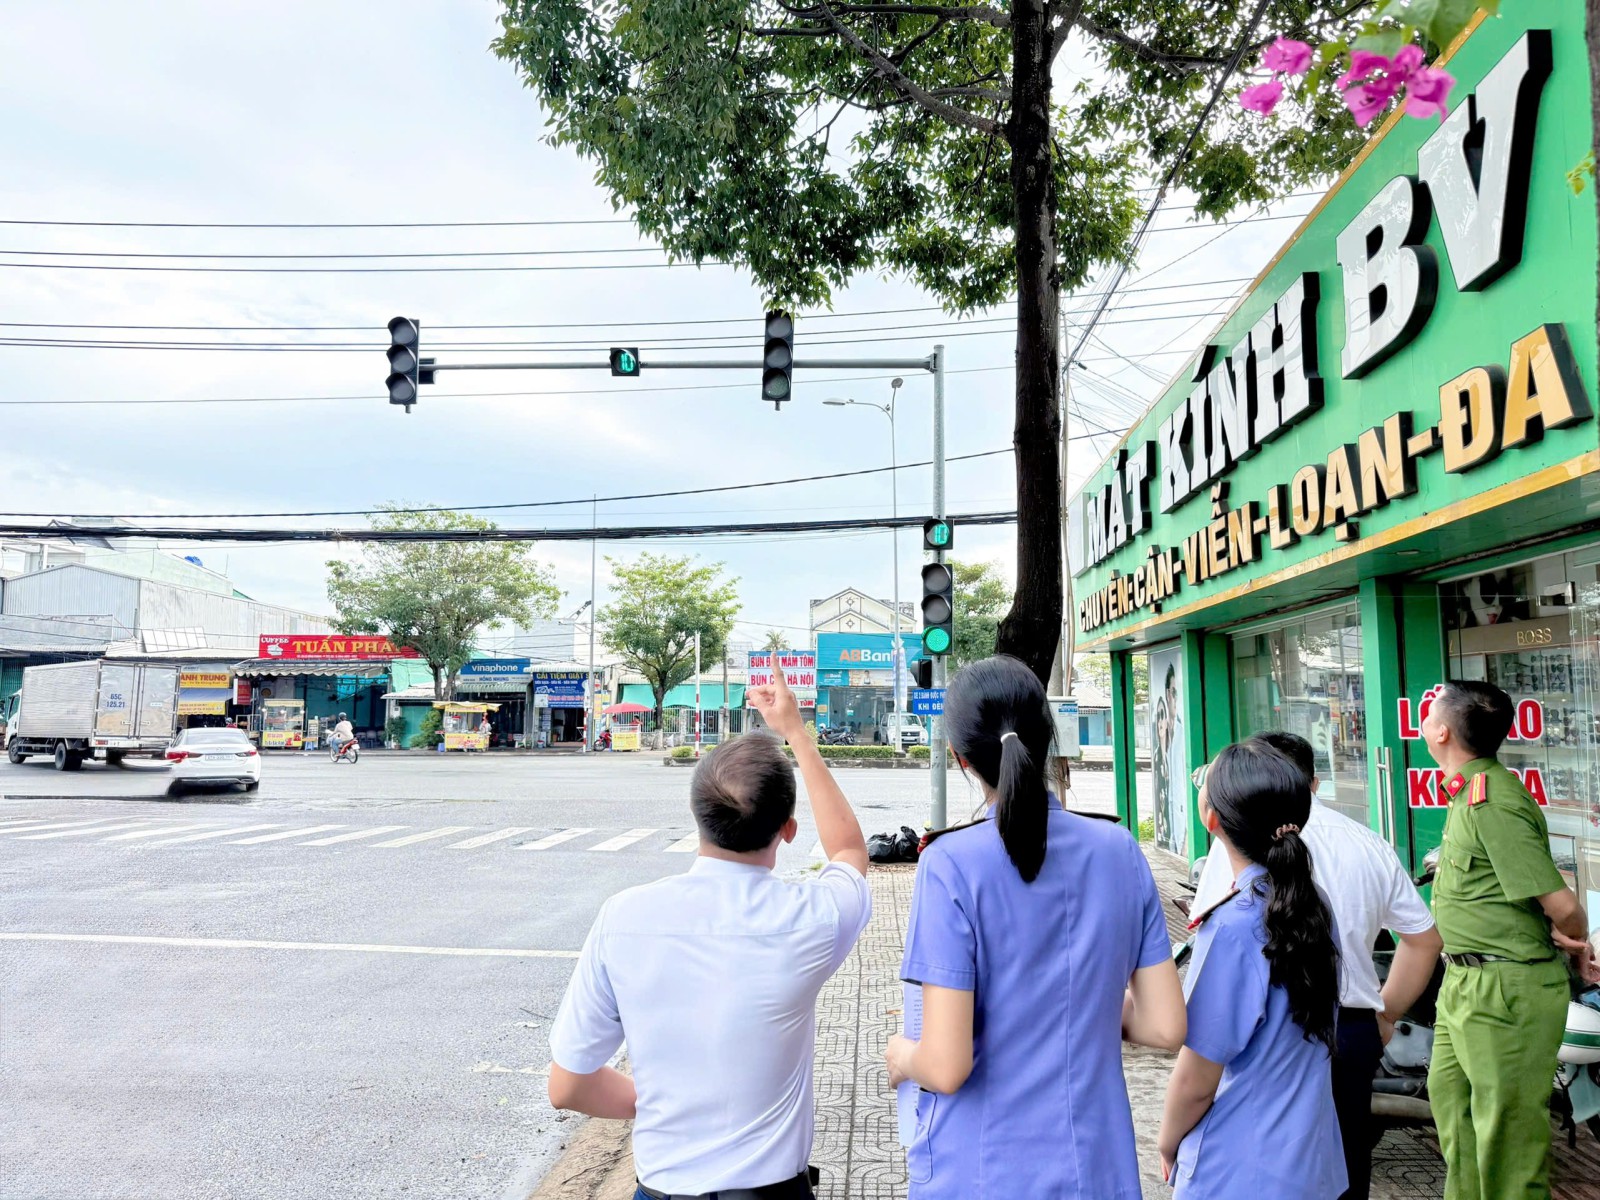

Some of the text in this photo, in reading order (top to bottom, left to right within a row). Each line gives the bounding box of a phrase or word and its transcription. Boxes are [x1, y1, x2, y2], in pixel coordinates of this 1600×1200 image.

[1158, 273, 1322, 514] KÍNH
[1336, 30, 1550, 379] BV
[934, 523, 949, 544] 10
[292, 635, 346, 653] TUẤN
[1516, 627, 1553, 646] BOSS
[800, 653, 814, 667] TÔM
[839, 649, 894, 662] ABBan
[472, 663, 519, 673] vinaphone
[750, 672, 767, 686] BÚN
[787, 671, 798, 685] HÀ
[800, 671, 814, 688] NỘI
[918, 702, 930, 710] KHI
